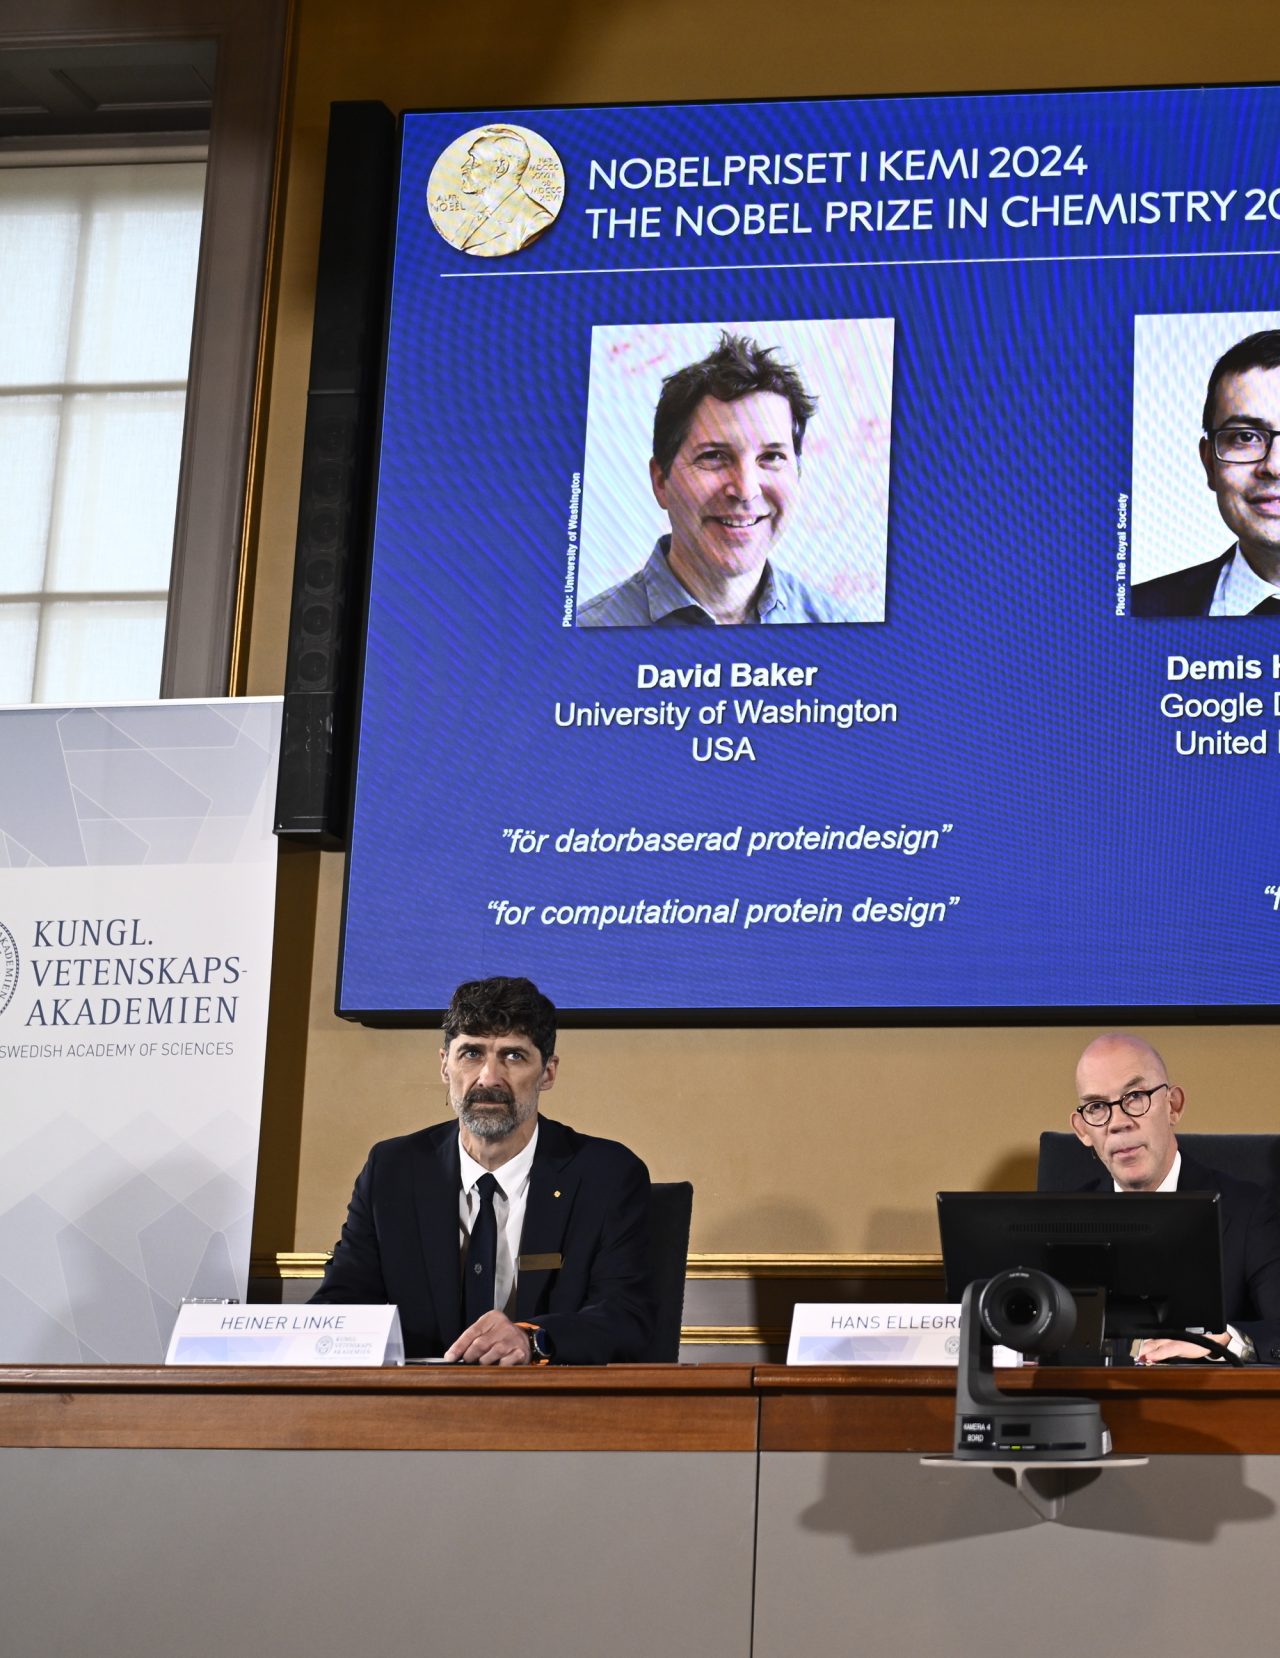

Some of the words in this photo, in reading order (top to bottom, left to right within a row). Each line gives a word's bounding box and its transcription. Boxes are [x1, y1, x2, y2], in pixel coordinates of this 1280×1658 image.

[590, 152, 851, 189] NOBELPRISET
[861, 152, 867, 181] I
[880, 149, 978, 181] KEMI
[989, 145, 1087, 178] 2024
[586, 207, 661, 238] THE
[676, 203, 812, 236] NOBEL
[826, 199, 933, 232] PRIZE
[949, 198, 987, 228] IN
[1002, 190, 1236, 227] CHEMISTRY
[568, 472, 581, 530] Washington
[1117, 493, 1128, 529] Society
[568, 530, 577, 541] of
[1117, 532, 1128, 560] Royal
[564, 544, 578, 592] University
[1116, 562, 1126, 581] The
[562, 595, 573, 627] Photo:
[1116, 583, 1125, 616] Photo:
[638, 664, 720, 688] David
[731, 663, 818, 687] Baker
[1168, 655, 1262, 680] Demis
[555, 701, 690, 730] University
[699, 700, 727, 724] of
[734, 699, 896, 728] Washington
[1161, 693, 1262, 721] Google
[693, 737, 755, 761] USA
[1176, 730, 1266, 754] United
[556, 827, 742, 852] datorbaserad
[541, 899, 738, 930] computational
[744, 898, 842, 929] protein
[35, 919, 152, 947] KUNGL.
[31, 957, 247, 986] VETENSKAPS-
[26, 997, 237, 1026] AKADEMIEN
[0, 1045, 62, 1058] SWEDISH
[67, 1044, 135, 1057] ACADEMY
[140, 1043, 157, 1056] OF
[162, 1042, 233, 1055] SCIENCES
[221, 1317, 287, 1329] HEINER
[293, 1316, 345, 1329] LINKE
[832, 1316, 880, 1328] HANS
[967, 1434, 984, 1442] BORD
